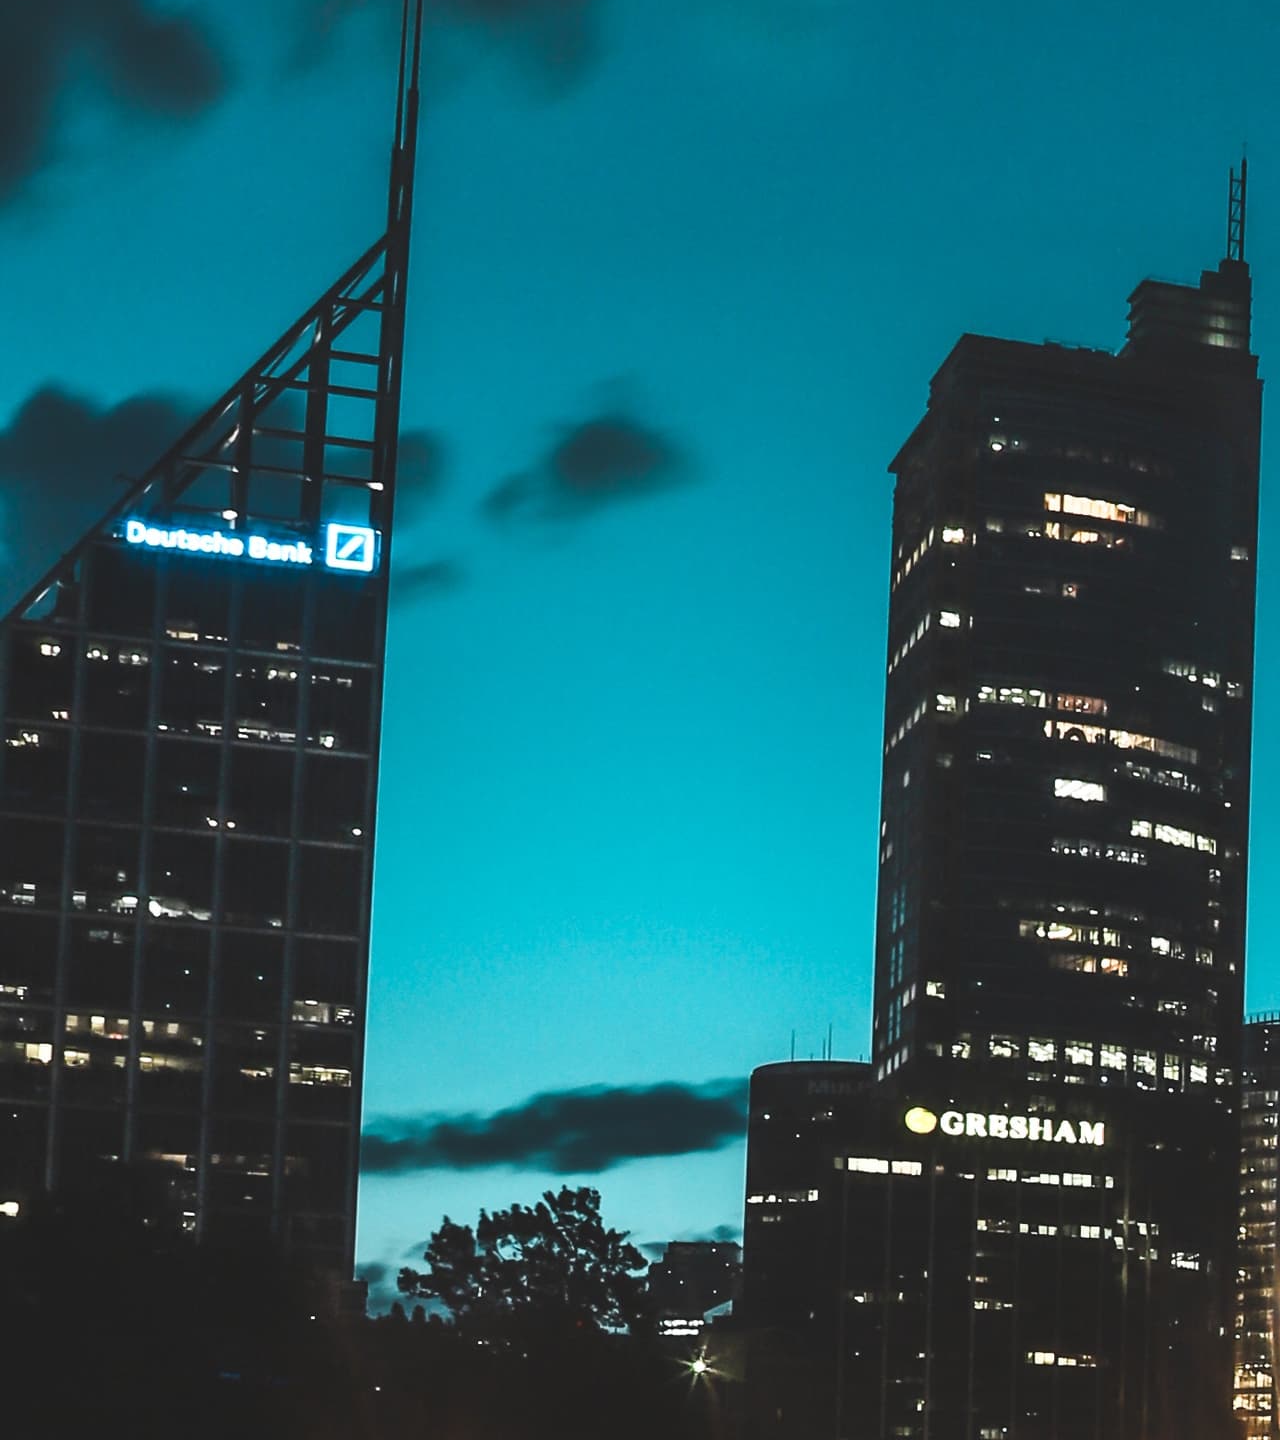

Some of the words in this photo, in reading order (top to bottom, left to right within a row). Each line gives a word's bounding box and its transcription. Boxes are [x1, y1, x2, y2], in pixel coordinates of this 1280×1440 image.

[126, 520, 244, 556] Deutsche
[248, 535, 313, 564] Bank
[940, 1111, 1105, 1146] GRESHAM
